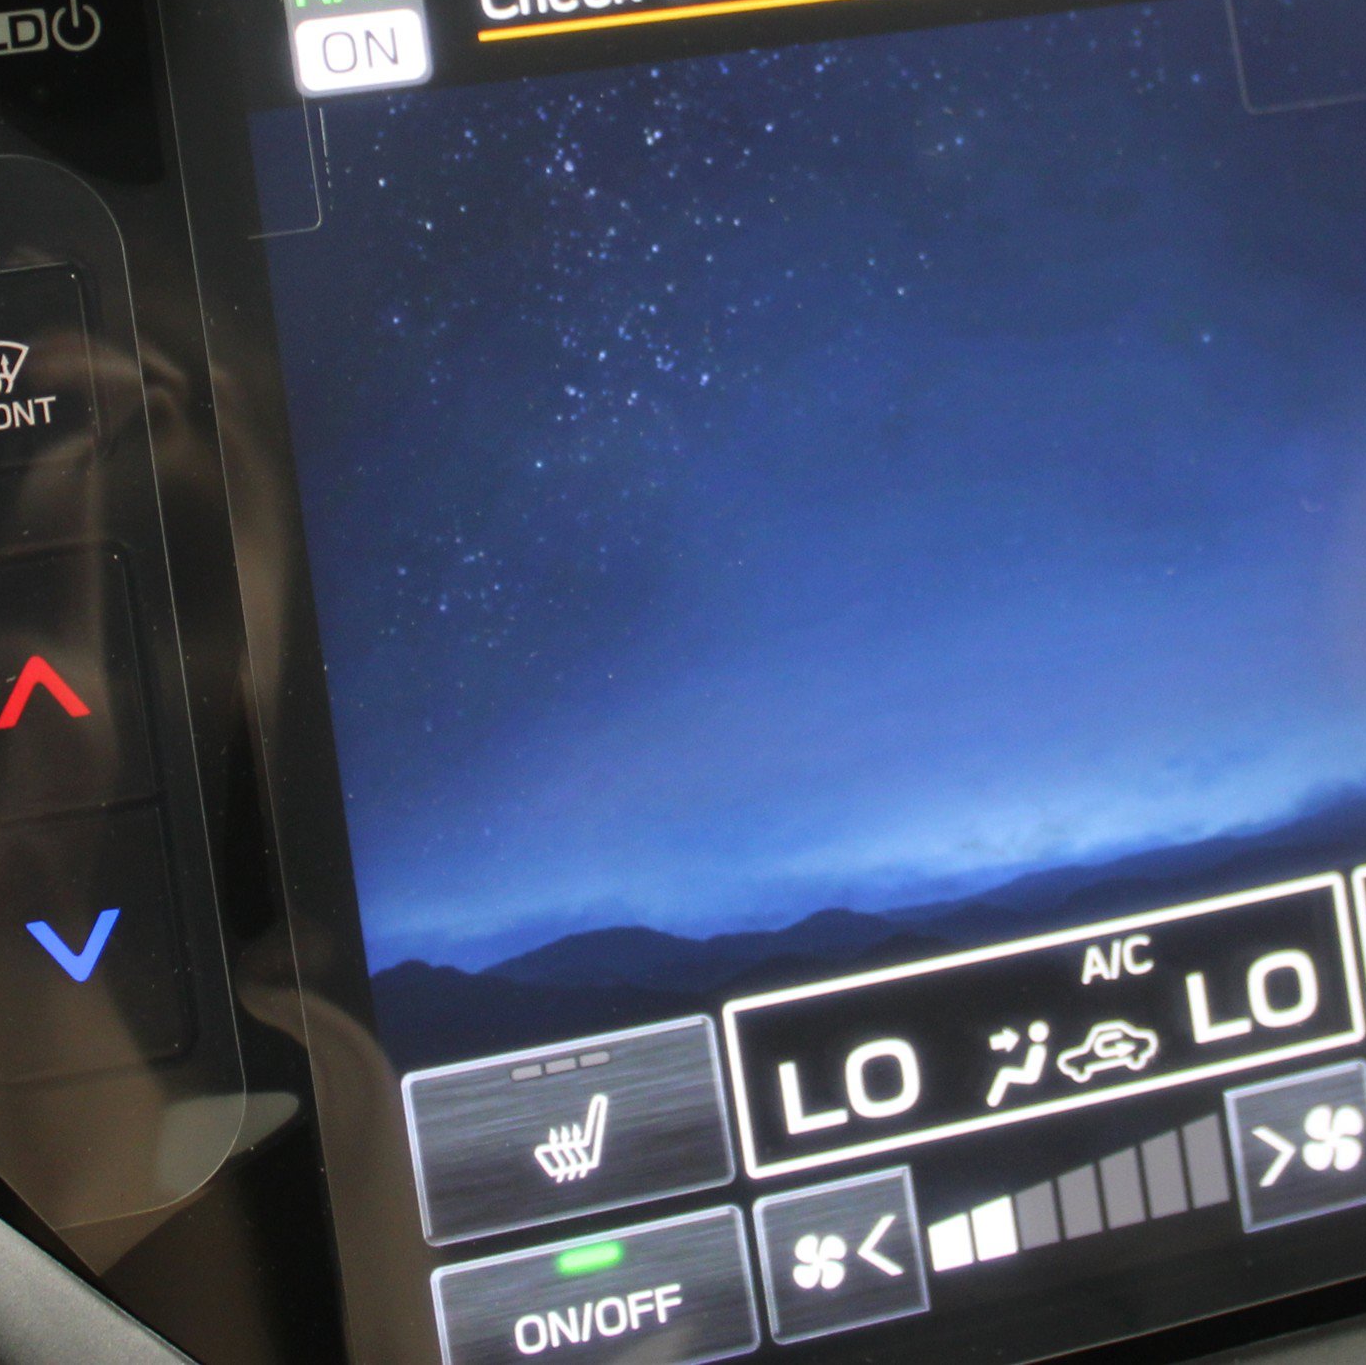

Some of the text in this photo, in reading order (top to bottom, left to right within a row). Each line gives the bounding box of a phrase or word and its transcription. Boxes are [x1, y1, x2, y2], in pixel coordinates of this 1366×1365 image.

[322, 26, 399, 74] ON
[1081, 934, 1154, 985] A/C
[1185, 949, 1319, 1044] LO
[777, 1038, 922, 1135] LO
[515, 1283, 682, 1354] ON/OFF
